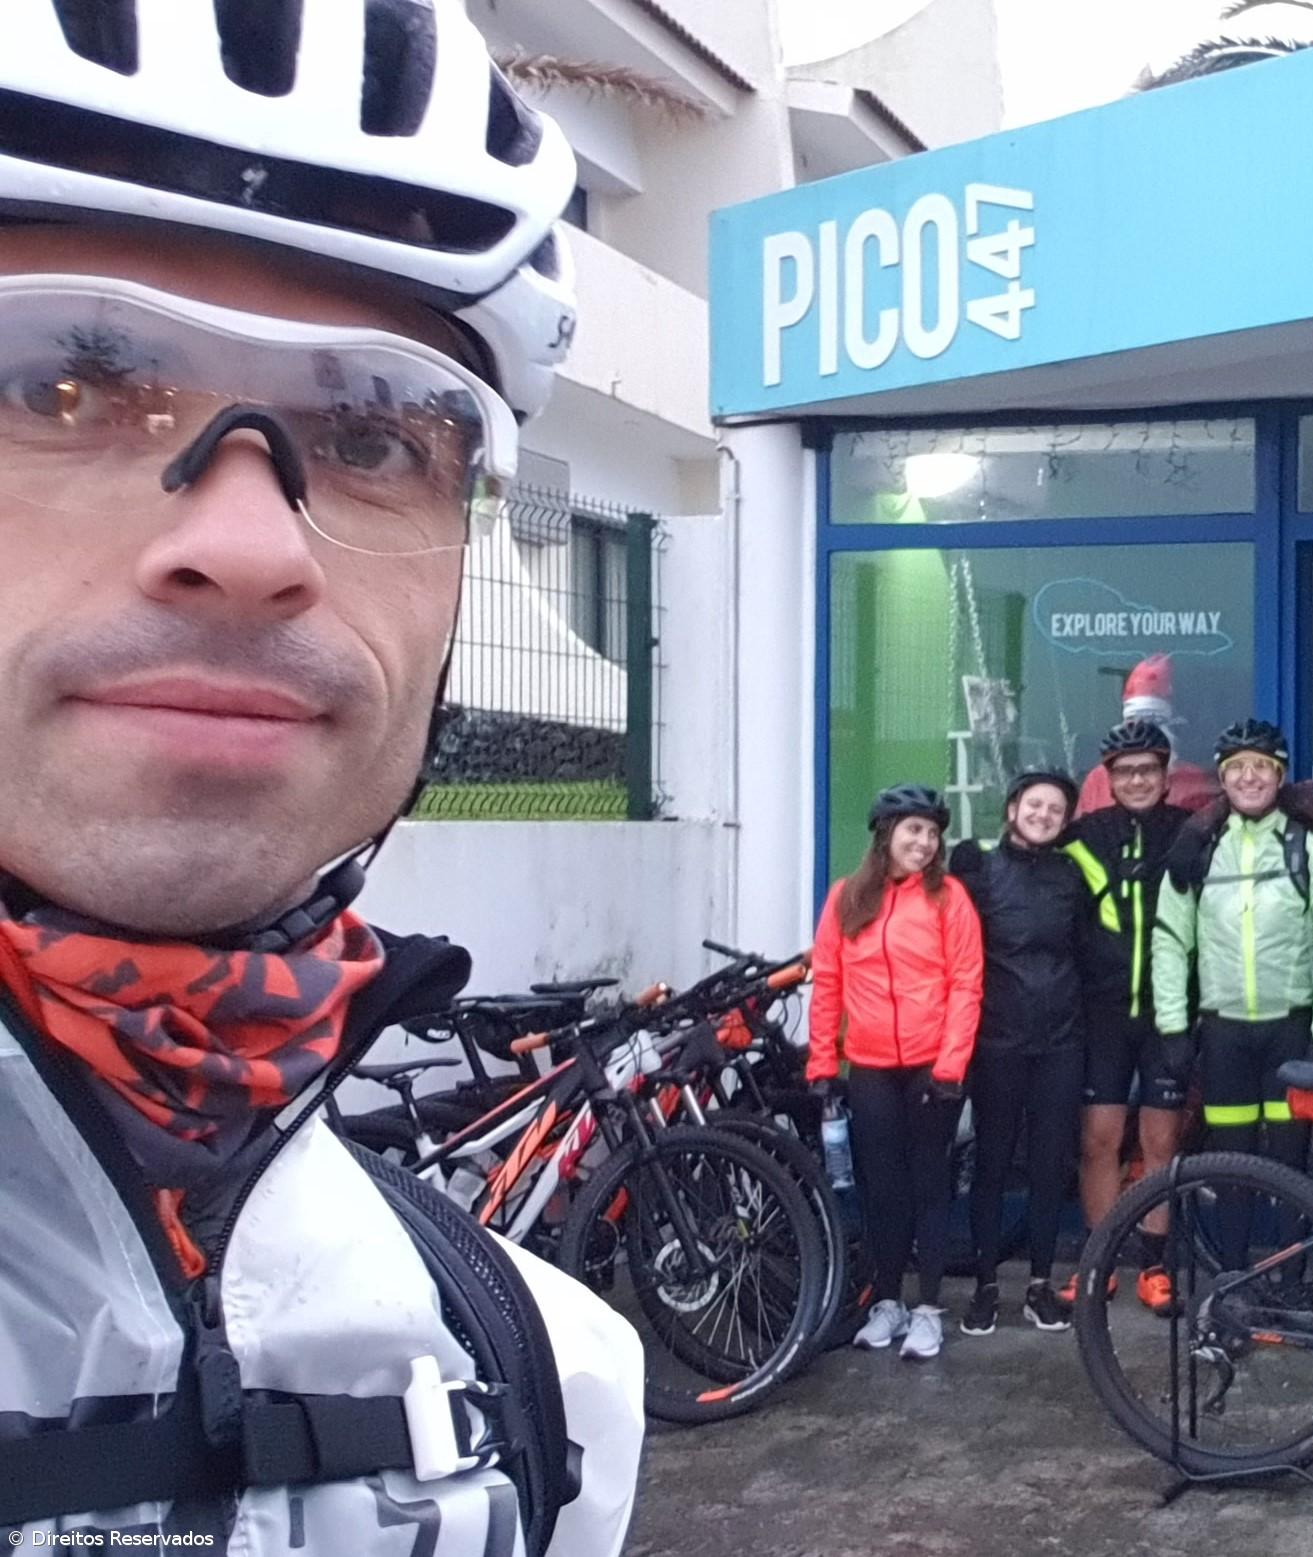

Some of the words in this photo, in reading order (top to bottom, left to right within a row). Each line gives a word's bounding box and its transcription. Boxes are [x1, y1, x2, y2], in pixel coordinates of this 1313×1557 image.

[763, 192, 959, 387] PICO
[966, 182, 1036, 341] 447
[1052, 613, 1128, 636] EXPLORE
[1130, 612, 1176, 635] YOUR
[1178, 612, 1221, 634] WAY
